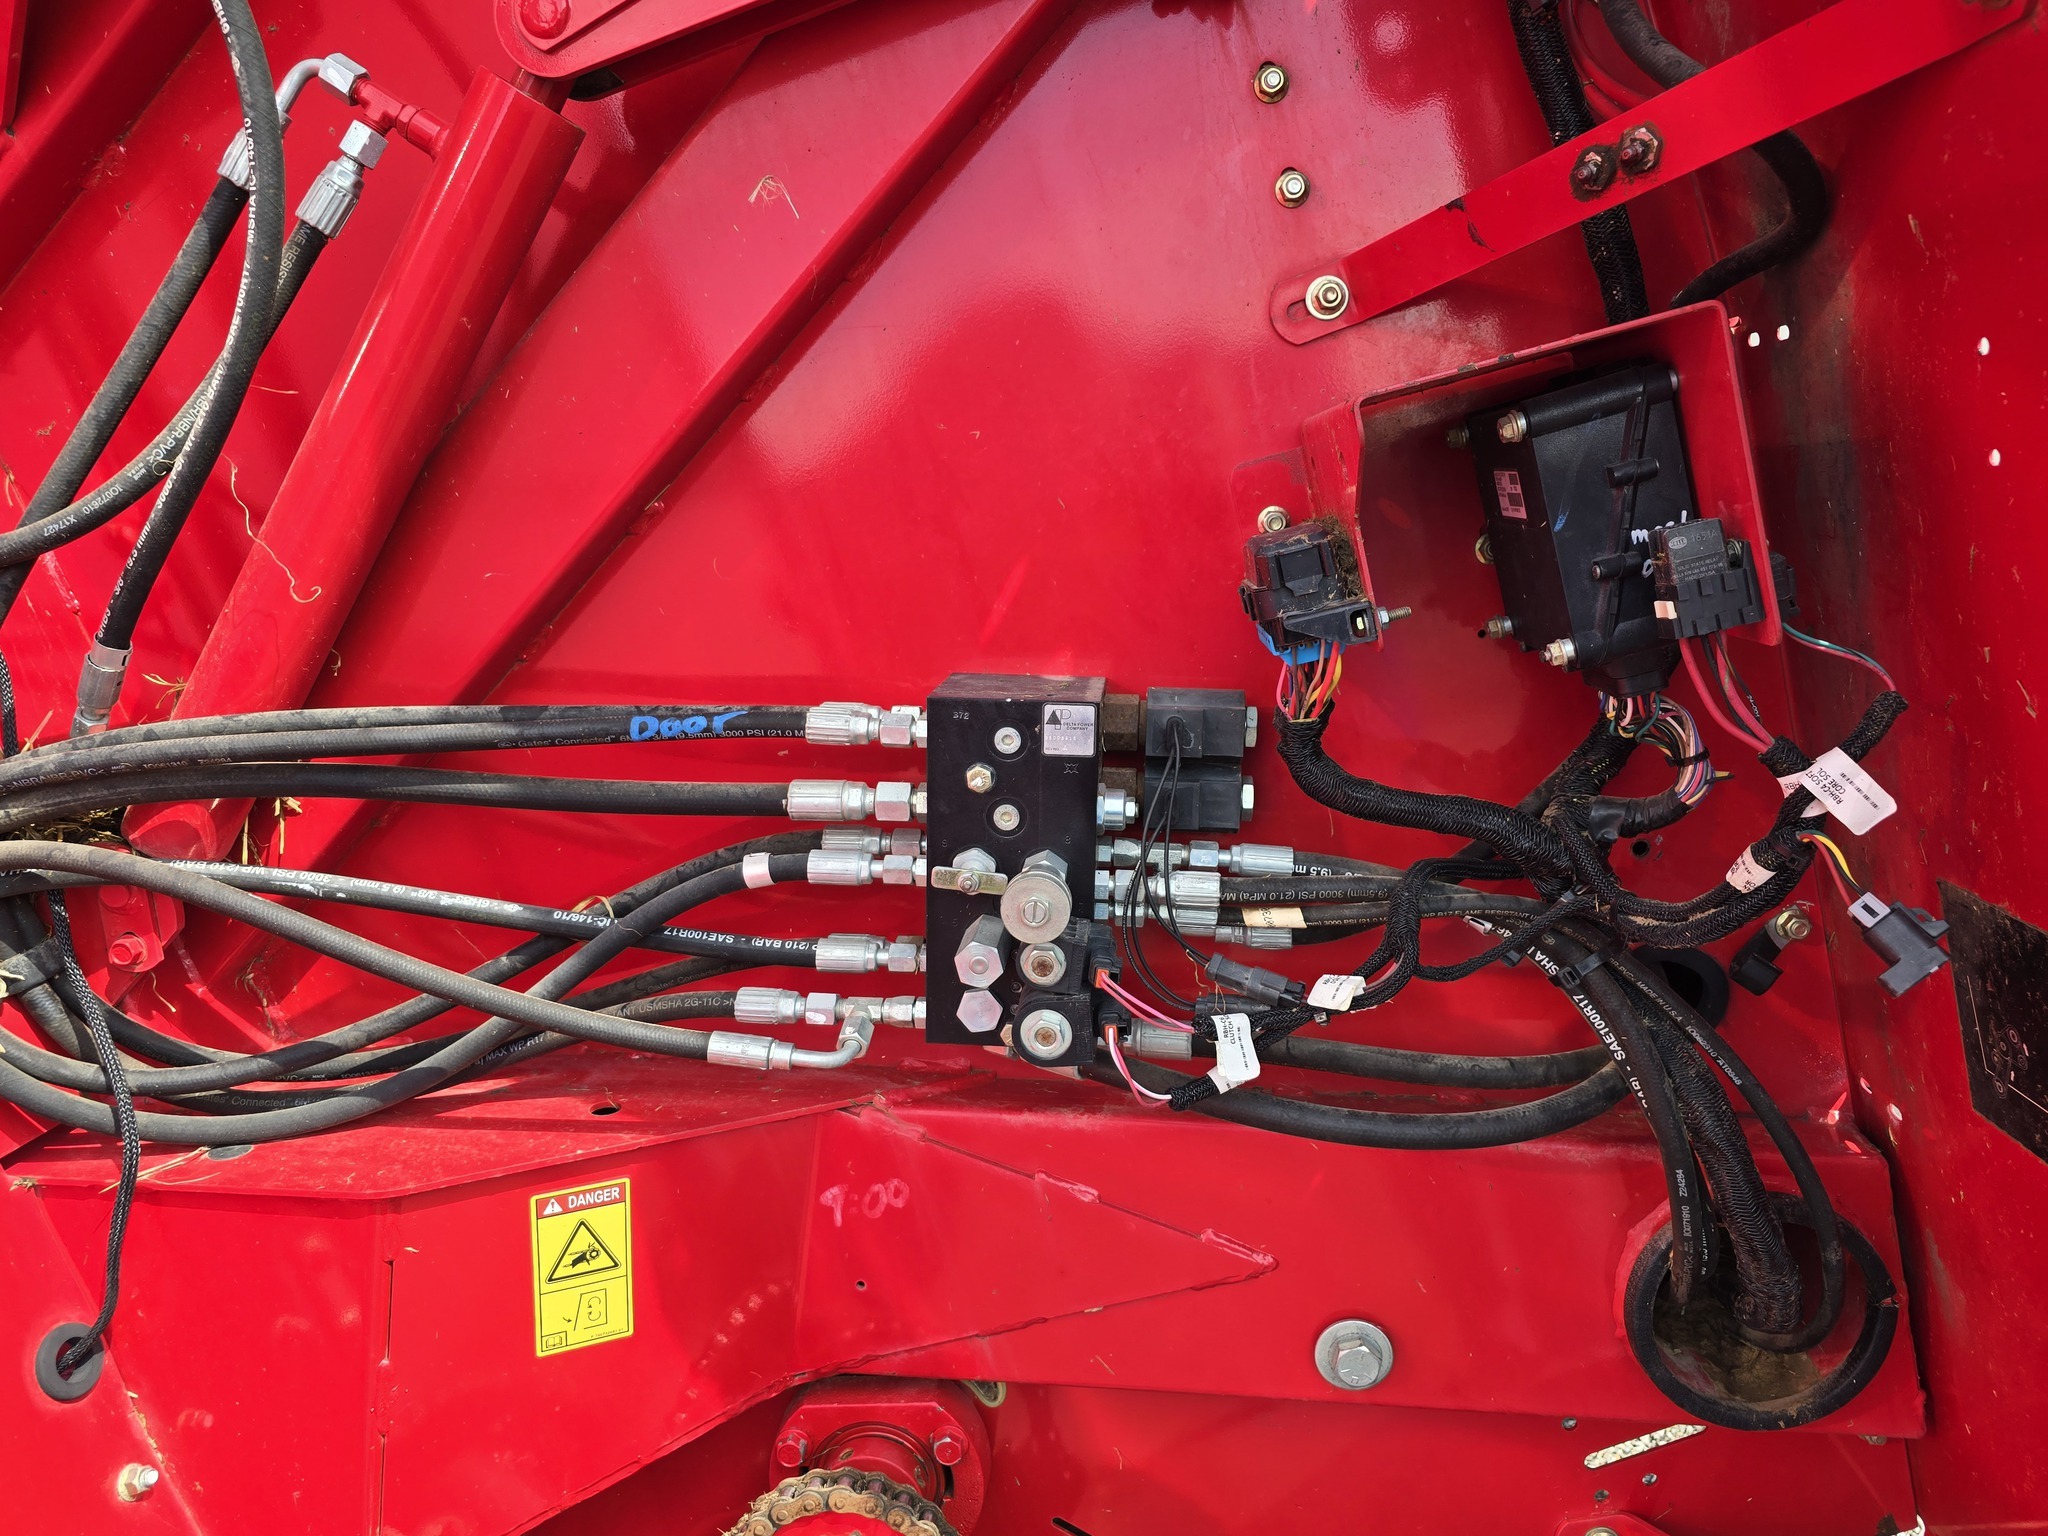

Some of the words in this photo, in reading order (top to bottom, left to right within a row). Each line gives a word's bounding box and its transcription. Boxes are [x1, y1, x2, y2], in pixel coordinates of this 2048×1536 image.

[244, 117, 257, 190] IC-146/10
[247, 194, 257, 243] MSHA
[43, 514, 78, 537] X17427
[953, 711, 970, 720] 372
[629, 710, 749, 742] Door
[746, 728, 765, 738] PSI
[767, 727, 792, 738] (21.0
[1805, 770, 1824, 787] SOFT
[1816, 767, 1831, 780] SOL
[1827, 778, 1847, 796] CORE
[210, 861, 241, 874] (210
[242, 865, 265, 877] WP
[272, 868, 295, 880] PSI
[300, 870, 330, 884] 3000
[350, 877, 379, 889] mm)
[1239, 889, 1268, 901] MPa)
[1268, 889, 1296, 901] (21.0
[1298, 889, 1317, 900] PSI
[1319, 888, 1344, 899] 3000
[1454, 908, 1484, 917] FLAME
[1485, 908, 1529, 919] RESISTANT
[664, 926, 736, 944] SAE100R17
[752, 937, 783, 949] BAR)
[785, 940, 811, 951] (210
[684, 996, 721, 1008] 2G-11C
[1572, 994, 1627, 1061] SAE100R17
[486, 1049, 508, 1063] MAX
[527, 1034, 545, 1047] R17
[568, 1186, 620, 1209] DANGER
